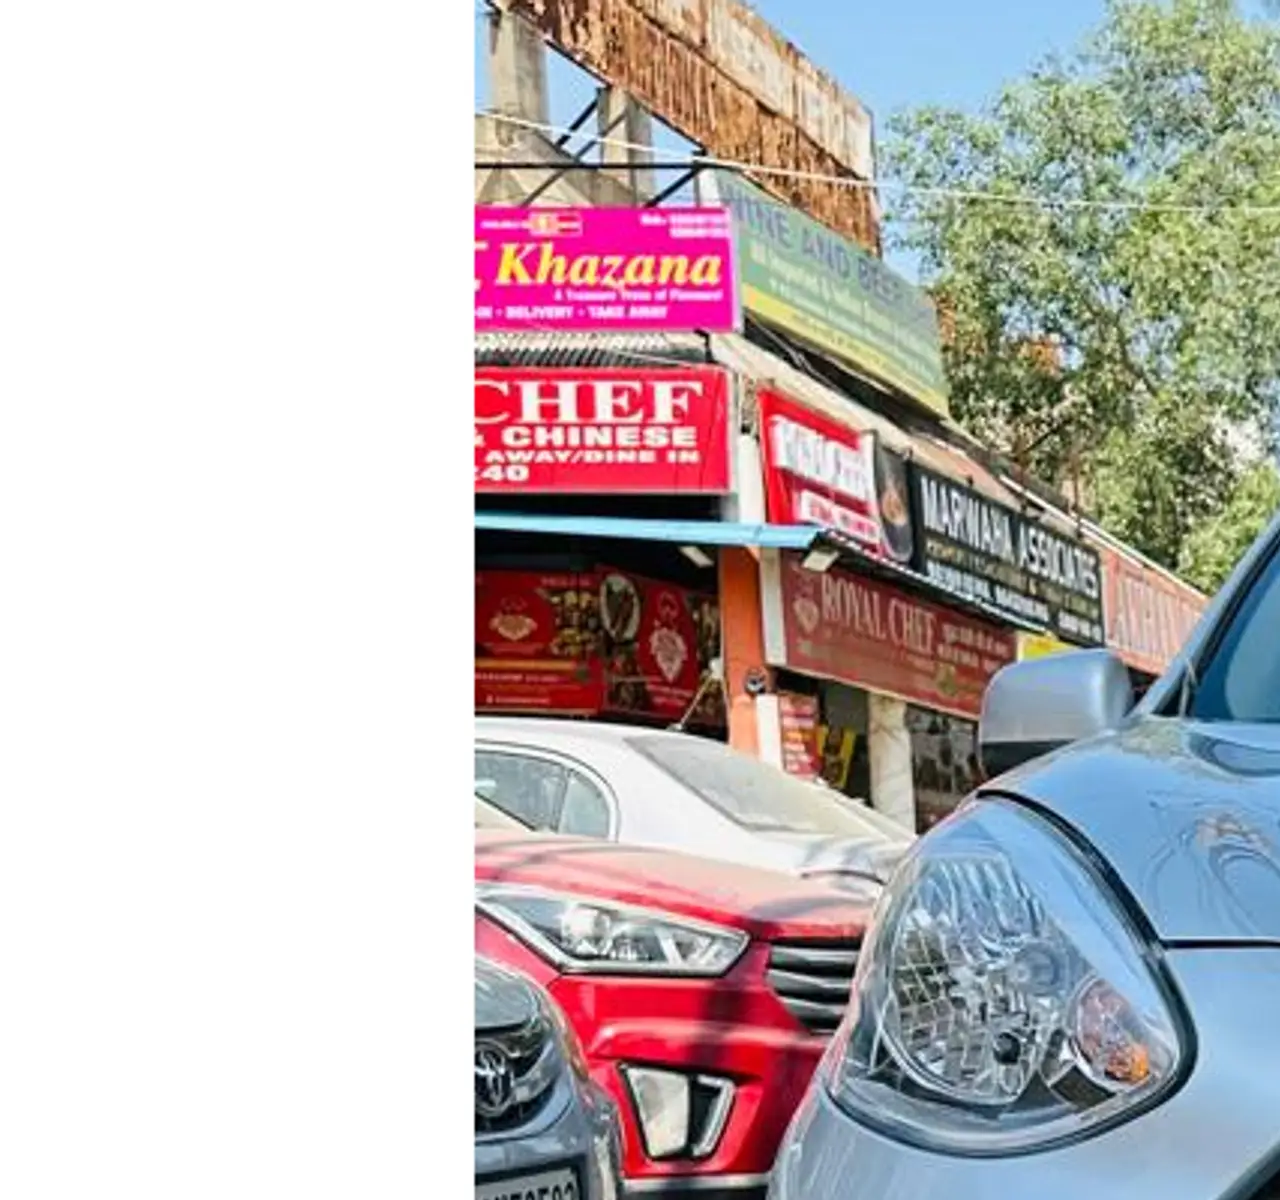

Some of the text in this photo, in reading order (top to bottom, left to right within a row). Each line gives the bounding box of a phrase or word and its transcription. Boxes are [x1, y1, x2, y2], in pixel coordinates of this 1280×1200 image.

[495, 240, 722, 290] Khazana
[803, 227, 850, 280] AND
[506, 305, 574, 319] DELIVERY
[588, 305, 623, 319] TAKE
[474, 379, 703, 425] CHEF
[485, 450, 700, 464] AWAY/DINE IN
[502, 425, 698, 448] CHINESE
[1019, 521, 1099, 600] ASSOCIATES
[821, 573, 887, 641] ROYAL
[888, 597, 939, 655] CHEF
